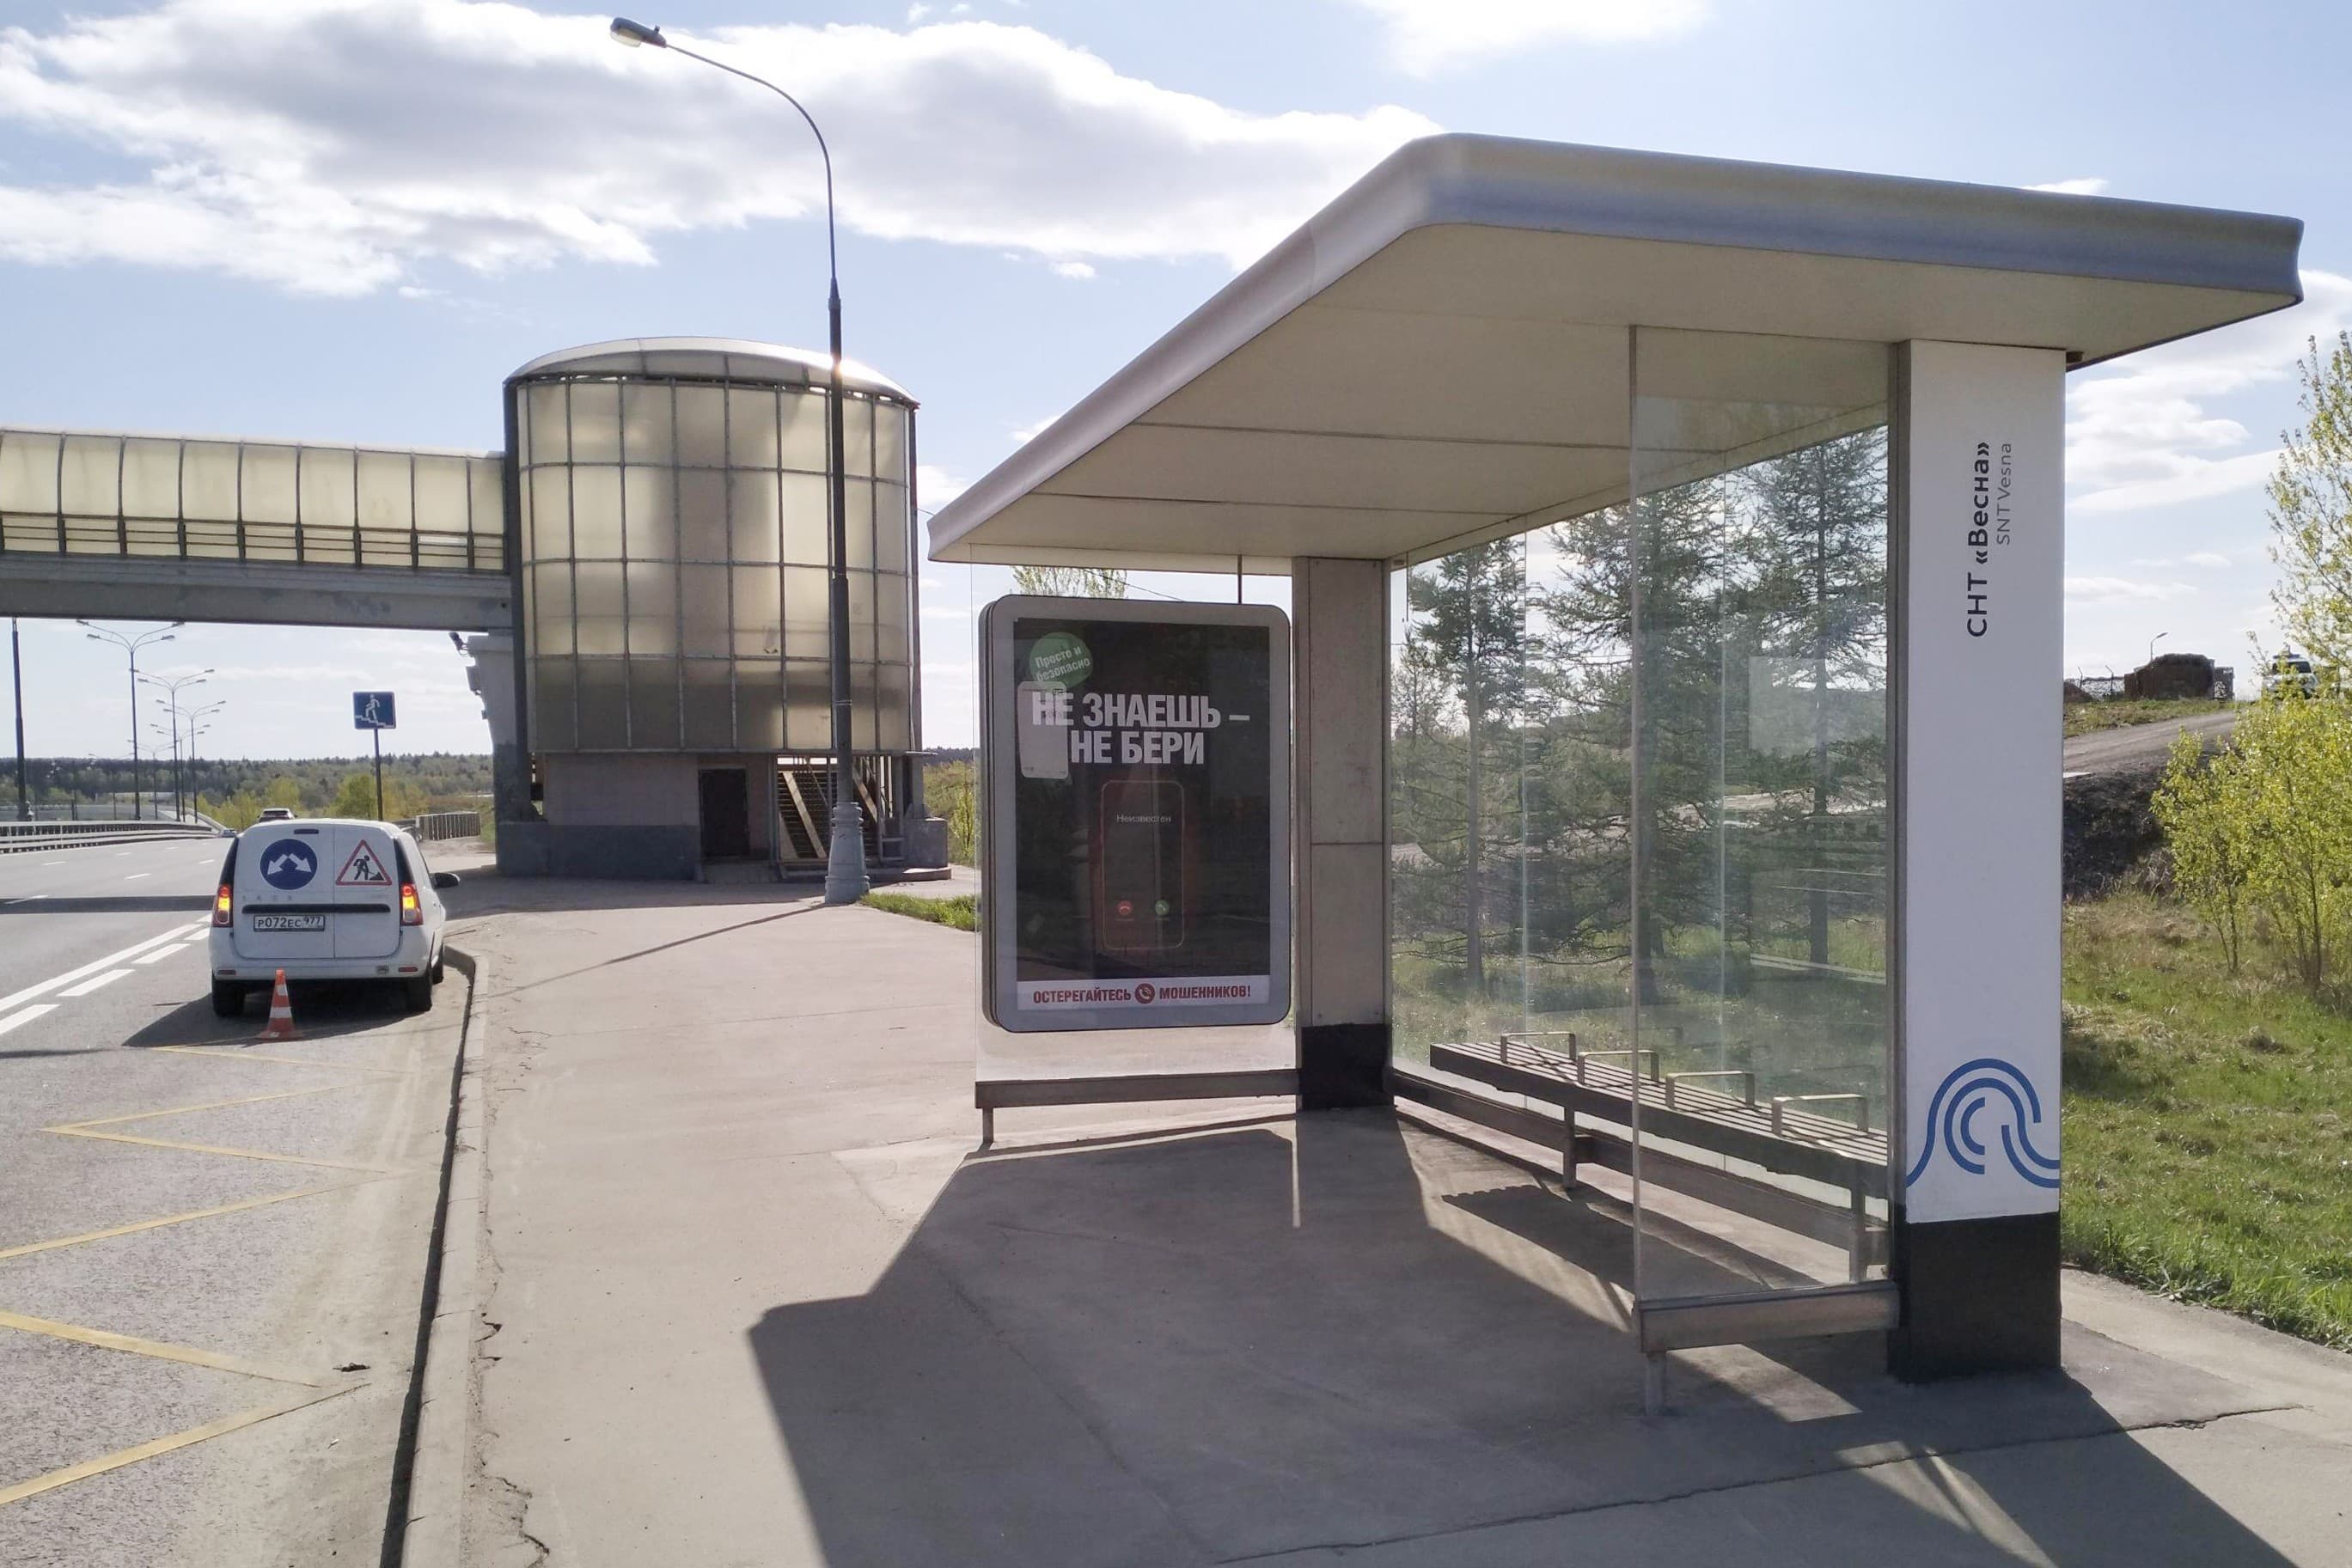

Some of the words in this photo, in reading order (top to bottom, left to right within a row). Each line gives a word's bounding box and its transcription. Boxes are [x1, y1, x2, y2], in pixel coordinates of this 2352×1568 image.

[1996, 443, 2012, 500] Vesna
[1967, 442, 1990, 564] «Весна»
[1996, 504, 2011, 545] SNT
[1966, 571, 1988, 638] СНТ
[1035, 650, 1072, 668] Просто
[1073, 646, 1082, 656] и
[1036, 656, 1090, 682] безопасно
[1031, 692, 1074, 726] НЕ
[1082, 692, 1221, 729] ЗНАЕШЬ
[1071, 730, 1112, 764] НЕ
[1121, 731, 1205, 765] БЕРИ
[1033, 986, 1132, 1004] ОСТЕРЕГАЙТЕСЬ
[1159, 985, 1251, 1000] МОШЕННИКОВ!
